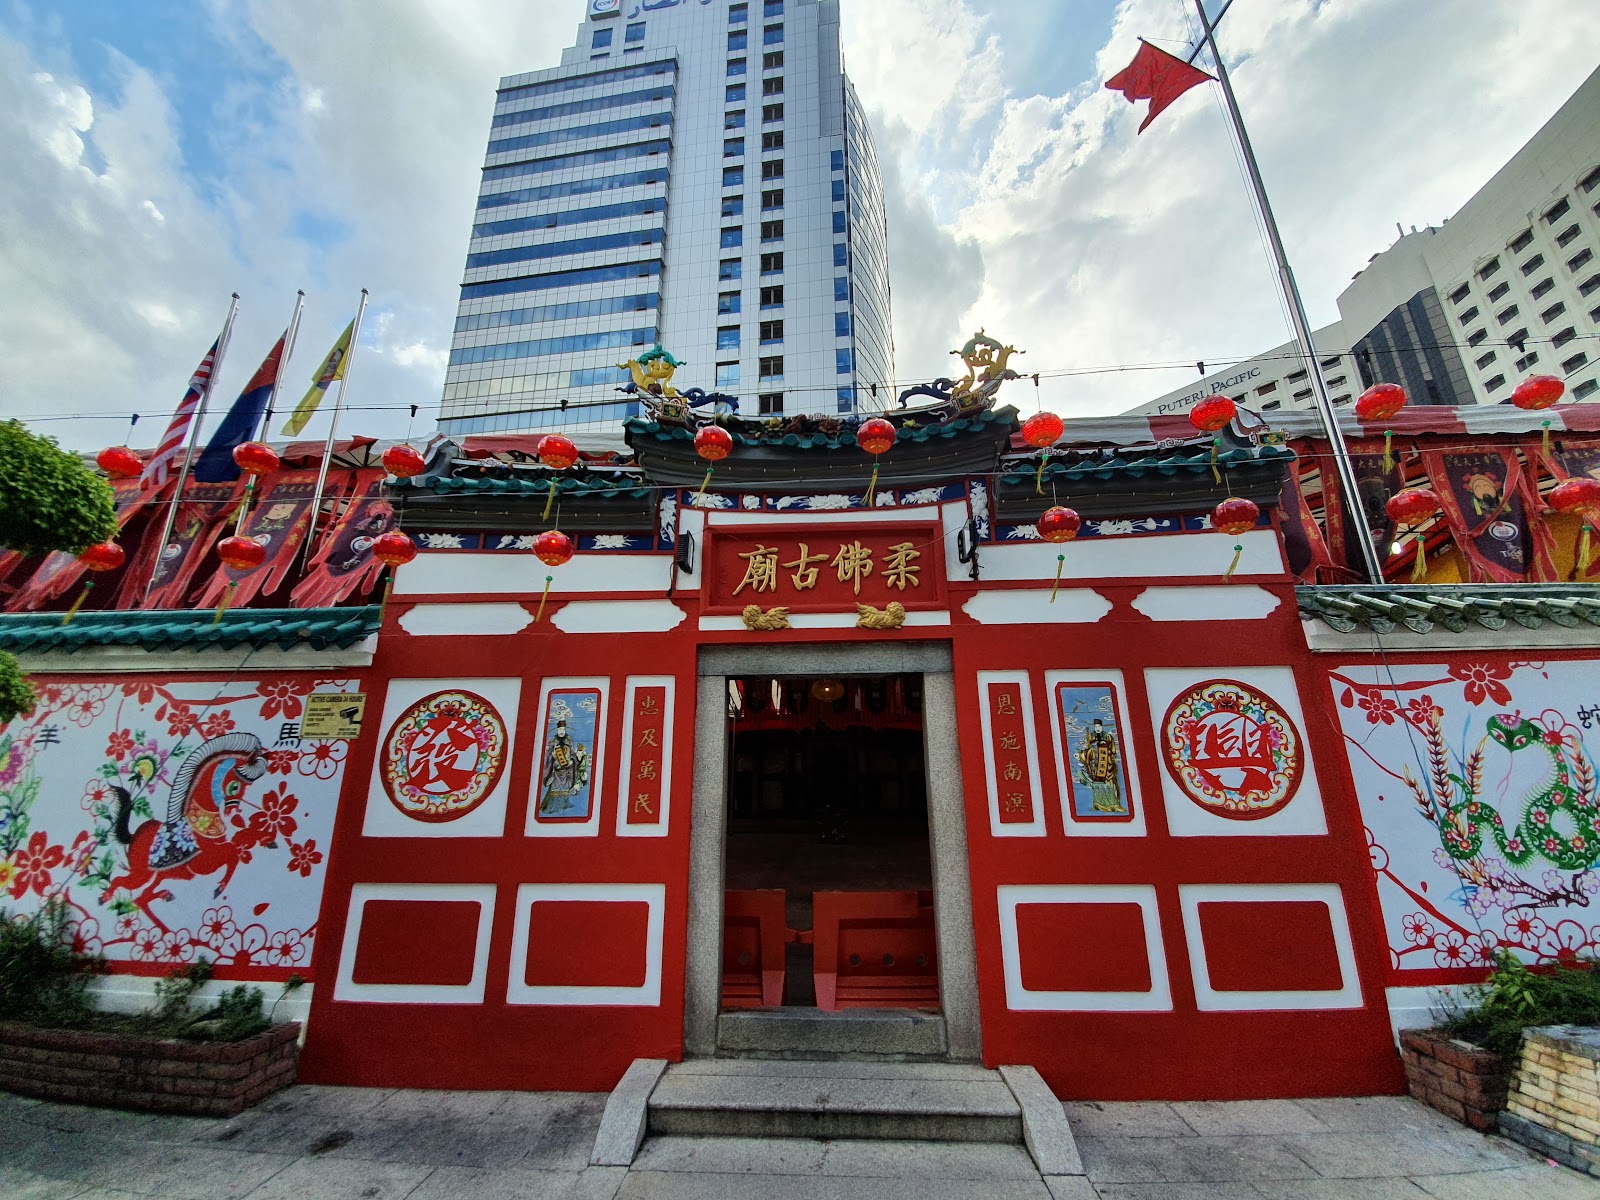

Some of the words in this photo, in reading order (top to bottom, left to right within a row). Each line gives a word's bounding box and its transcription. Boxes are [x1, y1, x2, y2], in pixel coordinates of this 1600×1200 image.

[1157, 390, 1206, 414] PUTERI
[1210, 367, 1261, 394] PACIFIC
[731, 539, 922, 596] 柔佛古廟
[34, 724, 61, 750] 羊
[272, 722, 302, 749] 馬
[997, 693, 1027, 814] 恩施南溟
